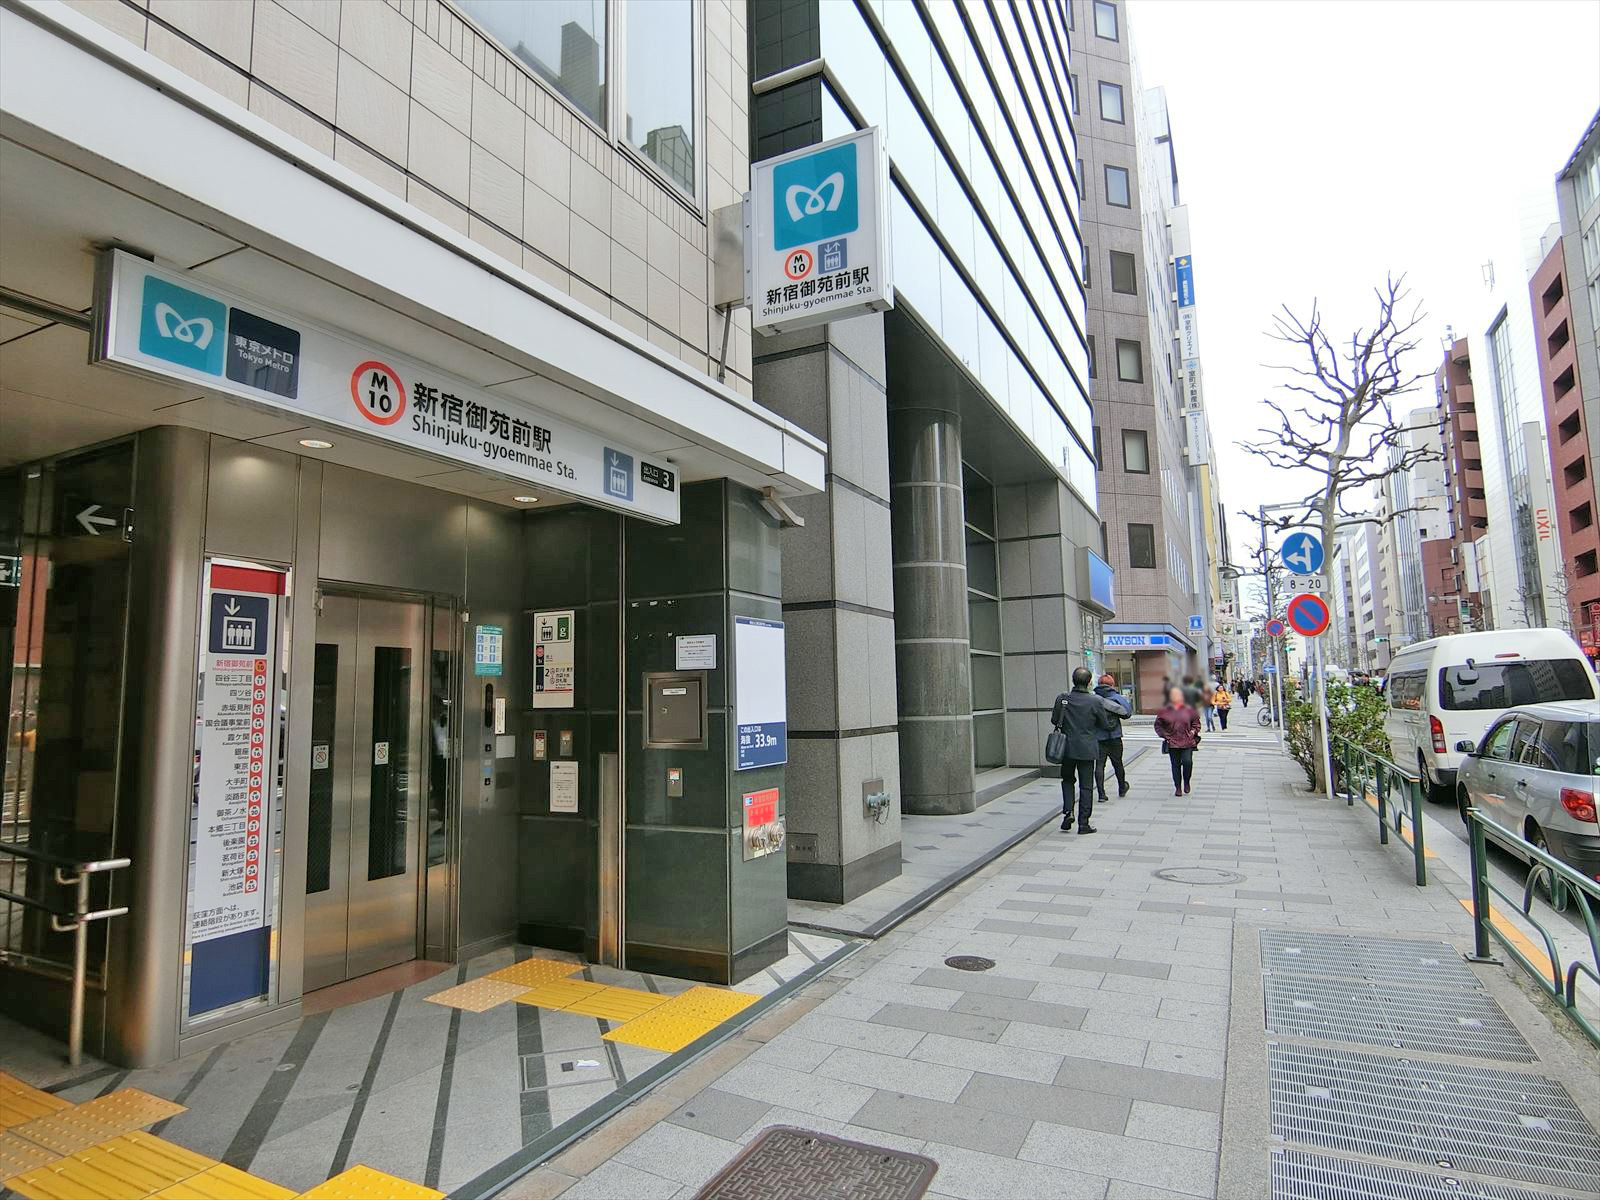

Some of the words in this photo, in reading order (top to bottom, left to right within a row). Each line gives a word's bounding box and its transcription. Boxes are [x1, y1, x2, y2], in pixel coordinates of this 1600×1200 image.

[792, 264, 806, 274] 10
[794, 254, 804, 265] M
[766, 266, 870, 306] 新宿御苑前駅
[762, 290, 854, 317] Shinjuku-gyoemmae
[856, 286, 875, 297] Sta.
[234, 335, 294, 364] 東京メトロ
[238, 349, 264, 364] Tokyo
[265, 358, 290, 373] Metro
[371, 372, 389, 392] M
[368, 390, 392, 413] 10
[412, 382, 552, 455] 新宿御苑前駅
[412, 414, 553, 473] Shinjuku-gyoemmae
[556, 461, 578, 481] Sta.
[662, 471, 670, 488] 3
[1535, 508, 1550, 542] LIXIL
[755, 733, 777, 748] 33.9m
